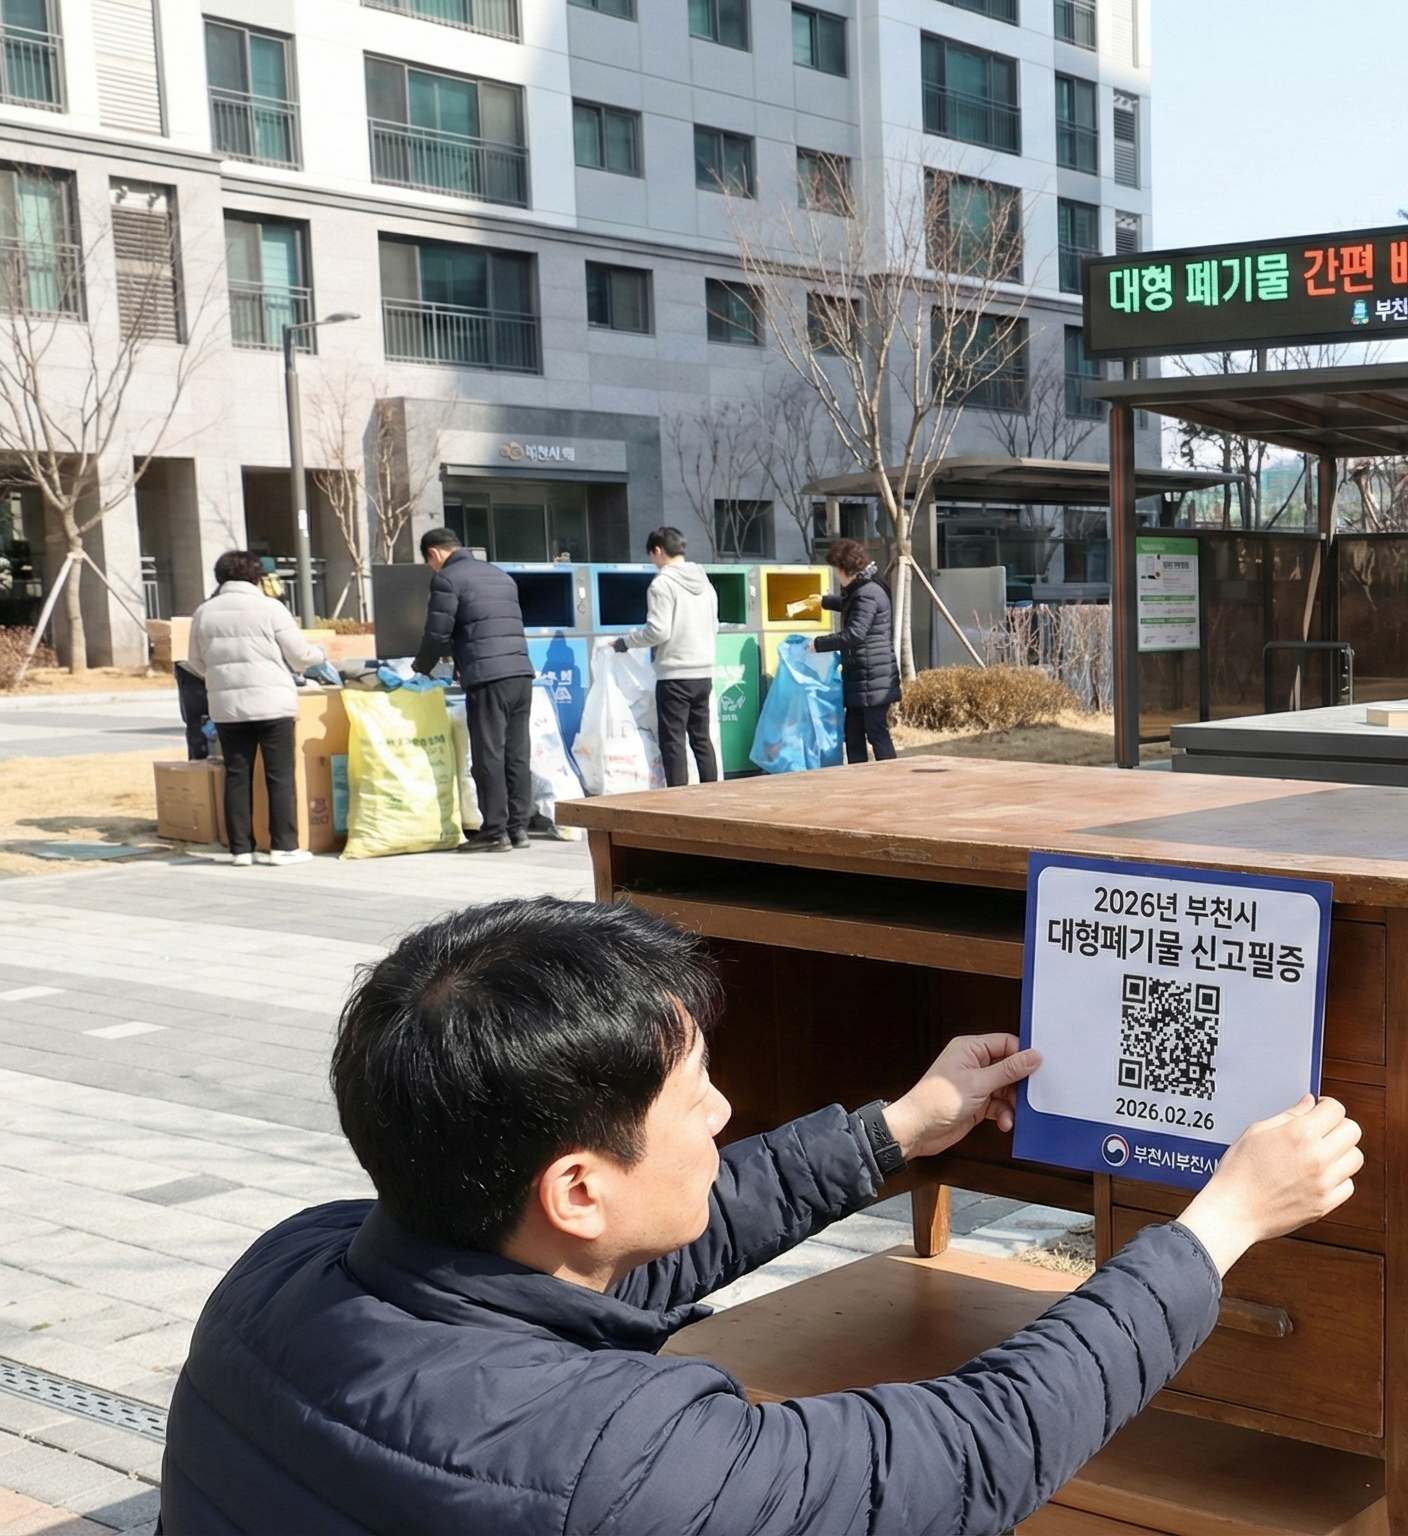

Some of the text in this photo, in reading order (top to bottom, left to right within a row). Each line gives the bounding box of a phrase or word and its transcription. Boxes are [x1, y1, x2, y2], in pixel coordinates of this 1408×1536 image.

[1108, 265, 1173, 314] 대형
[1185, 252, 1290, 308] 폐기물
[1303, 241, 1374, 297] 간편
[1094, 886, 1257, 932] 2026년 부천시
[1047, 918, 1305, 983] 대형폐기물 신고필증
[1115, 1097, 1215, 1131] 2026.02.26
